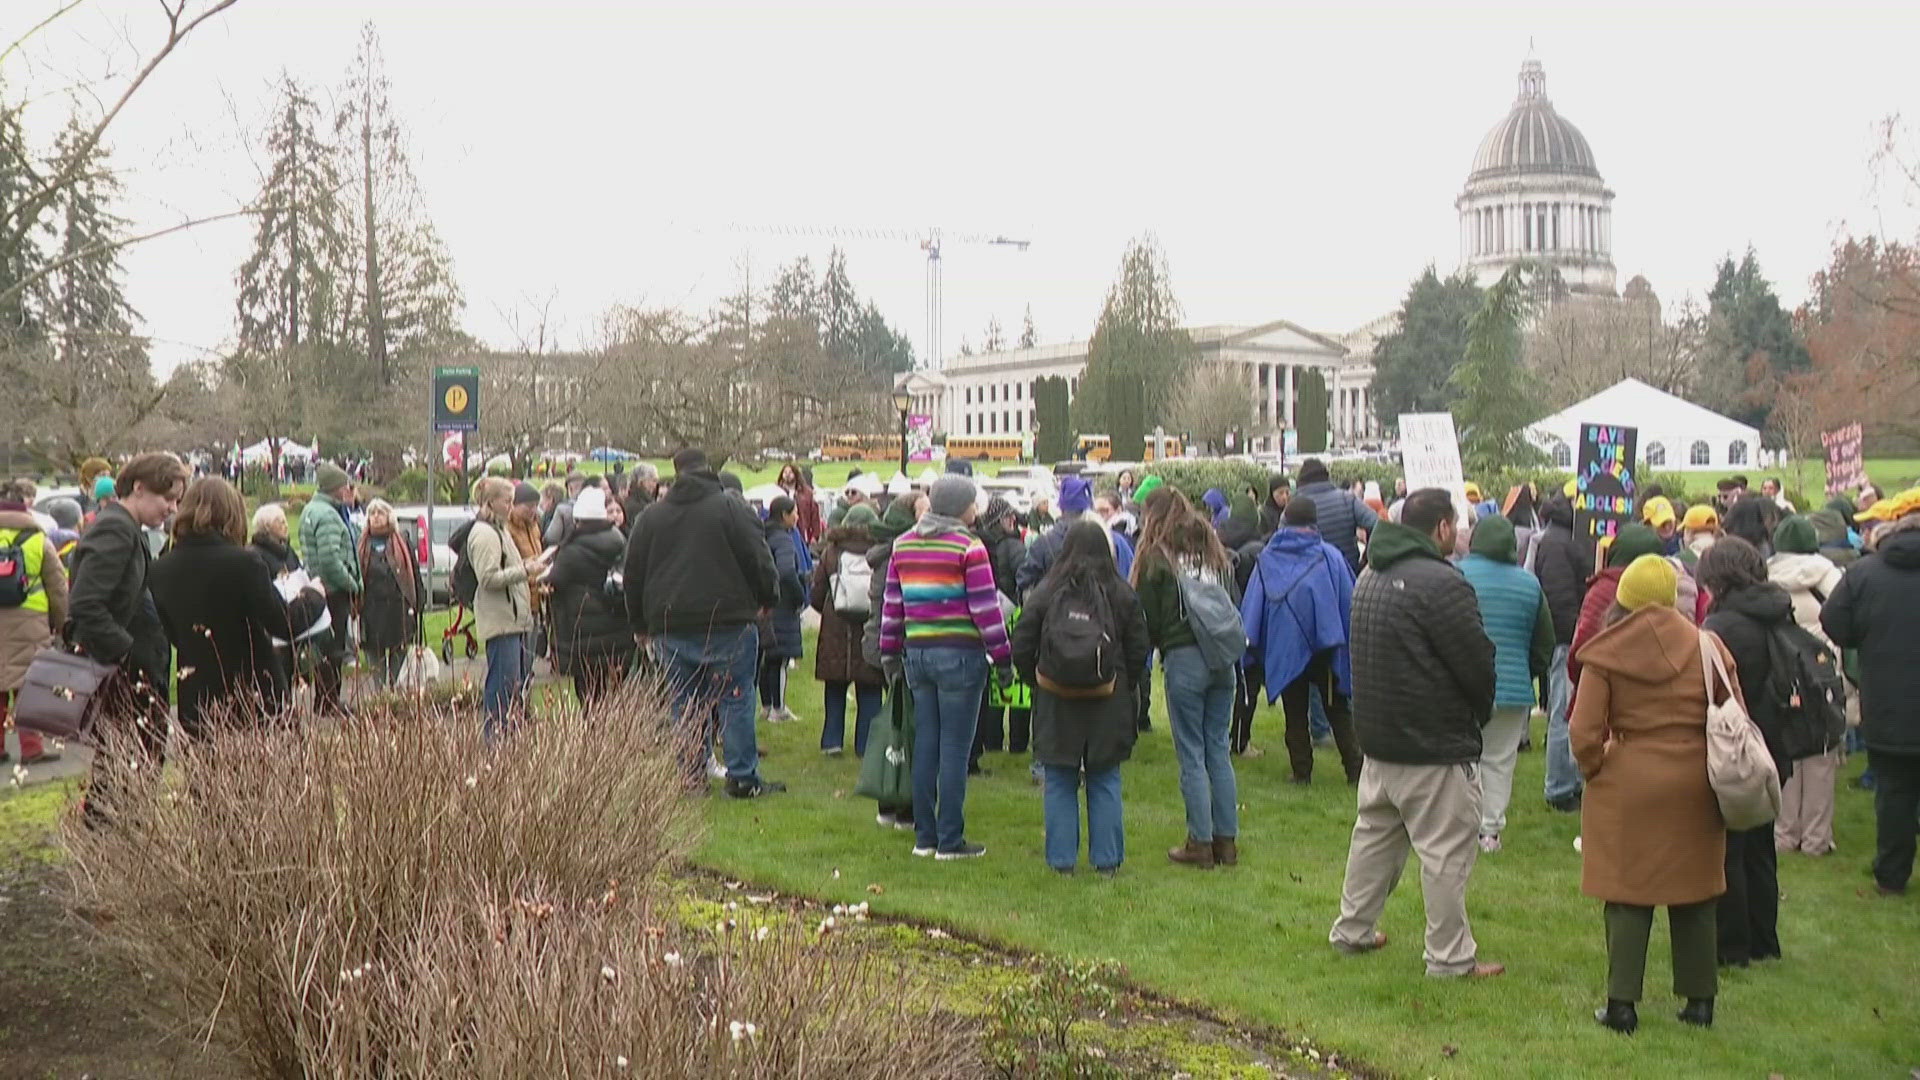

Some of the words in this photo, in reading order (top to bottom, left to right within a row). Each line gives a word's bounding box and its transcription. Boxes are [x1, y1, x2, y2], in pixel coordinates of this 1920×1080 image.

[451, 389, 462, 409] P
[1588, 426, 1625, 444] SAVE
[1599, 443, 1625, 461] THE
[1577, 459, 1636, 493] GLACIERS
[1575, 493, 1633, 515] ABOLISH
[1589, 518, 1617, 538] ICE
